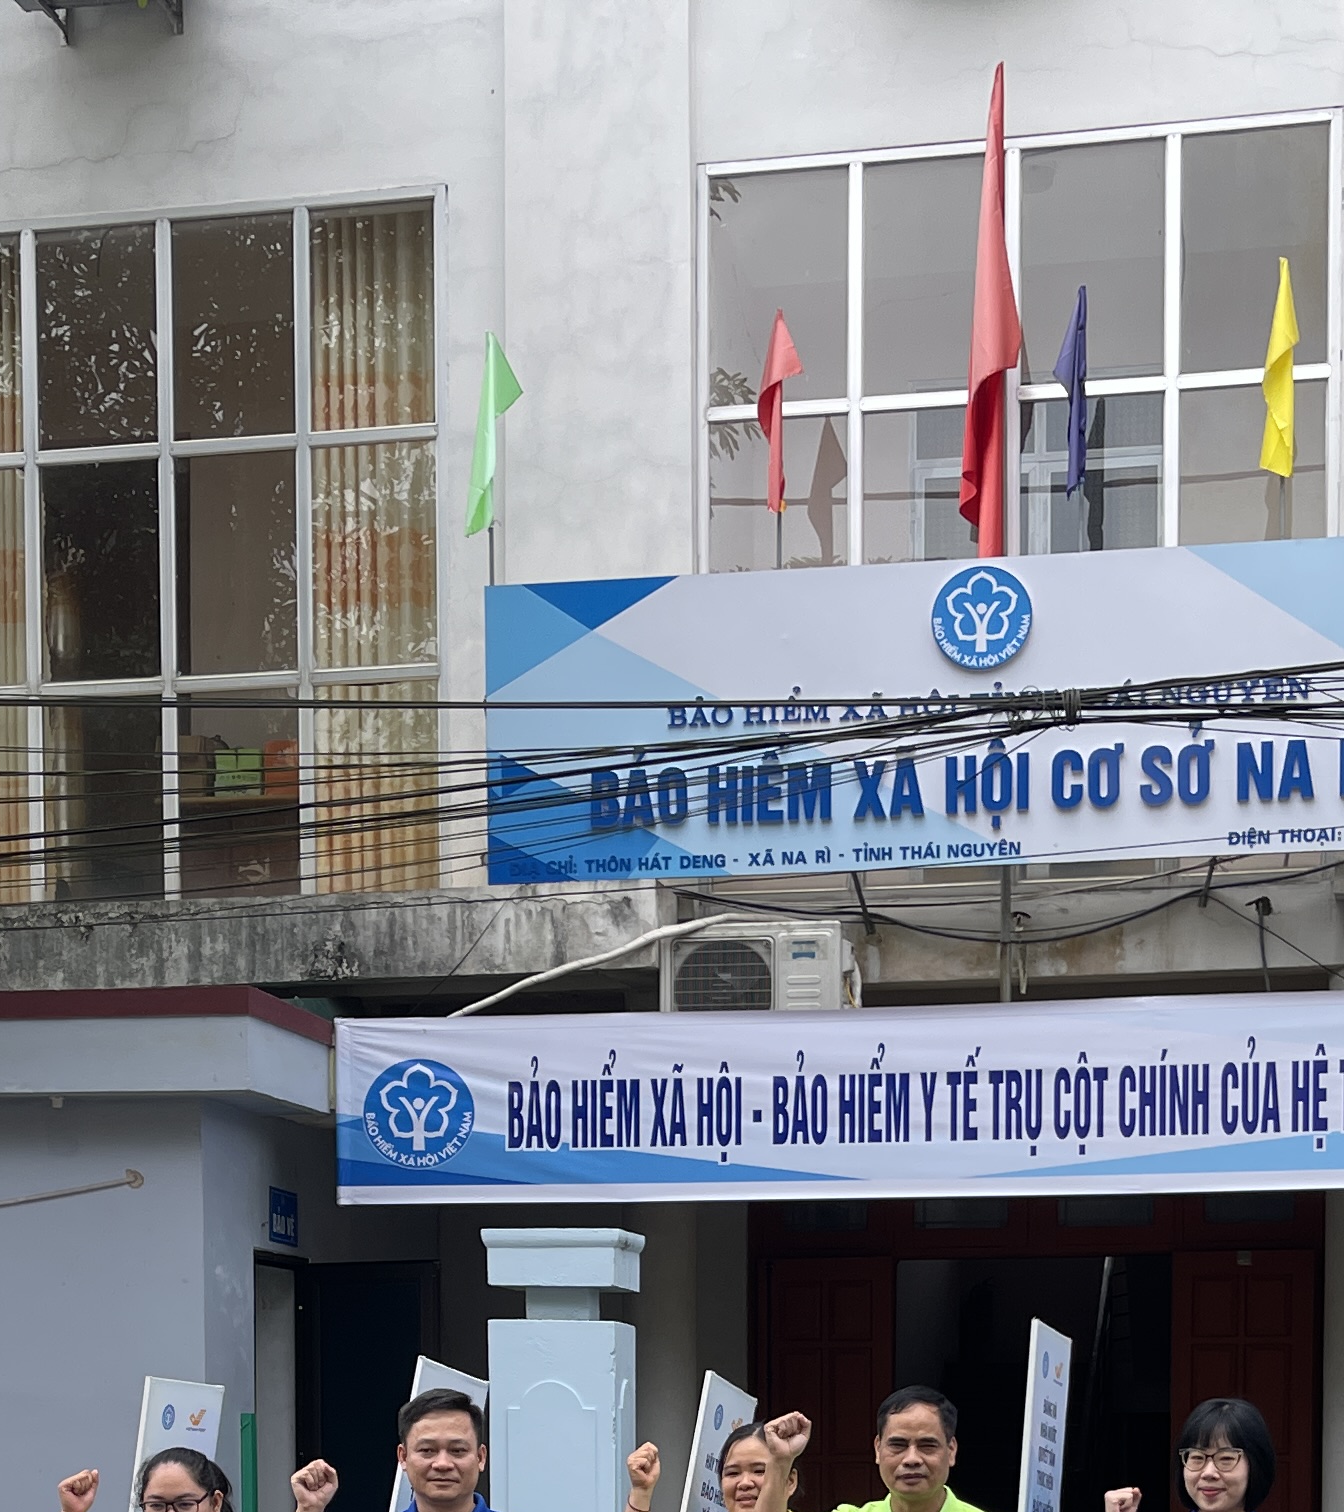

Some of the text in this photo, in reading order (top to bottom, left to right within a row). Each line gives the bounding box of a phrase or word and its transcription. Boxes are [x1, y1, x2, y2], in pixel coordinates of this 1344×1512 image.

[1017, 614, 1031, 640] NAM
[853, 745, 925, 818] XÃ
[945, 737, 1030, 830] HỘI
[1051, 742, 1124, 809] CƠ
[1140, 721, 1216, 807] SỞ
[1237, 739, 1315, 802] NA
[584, 854, 632, 874] THÔN
[638, 851, 672, 872] HÁT
[680, 854, 726, 871] DENG
[748, 847, 774, 867] XÃ
[782, 850, 808, 866] NA
[815, 846, 832, 865] RÌ
[853, 843, 893, 863] TỈNH
[899, 841, 940, 861] THÁI
[947, 839, 1022, 860] NGUYÊN
[1228, 827, 1270, 848] ĐIỆN
[1279, 827, 1342, 847] THOẠI:
[506, 1055, 562, 1151] BẢO
[571, 1049, 640, 1149] HIỂM
[650, 1063, 690, 1146] XÃ
[697, 1061, 743, 1162] HỘI
[772, 1050, 828, 1146] BẢO
[838, 1042, 910, 1144] HIỂM
[919, 1071, 940, 1143] Y
[946, 1046, 978, 1142] TẾ
[991, 1068, 1044, 1157] TRỤ
[1055, 1051, 1109, 1155] CỘT
[1119, 1048, 1210, 1140] CHÍNH
[1220, 1035, 1281, 1136] CỦA
[1291, 1043, 1329, 1151] HỆ
[417, 1154, 439, 1167] HỘI
[439, 1138, 463, 1159] VIỆT
[459, 1111, 473, 1138] NAM
